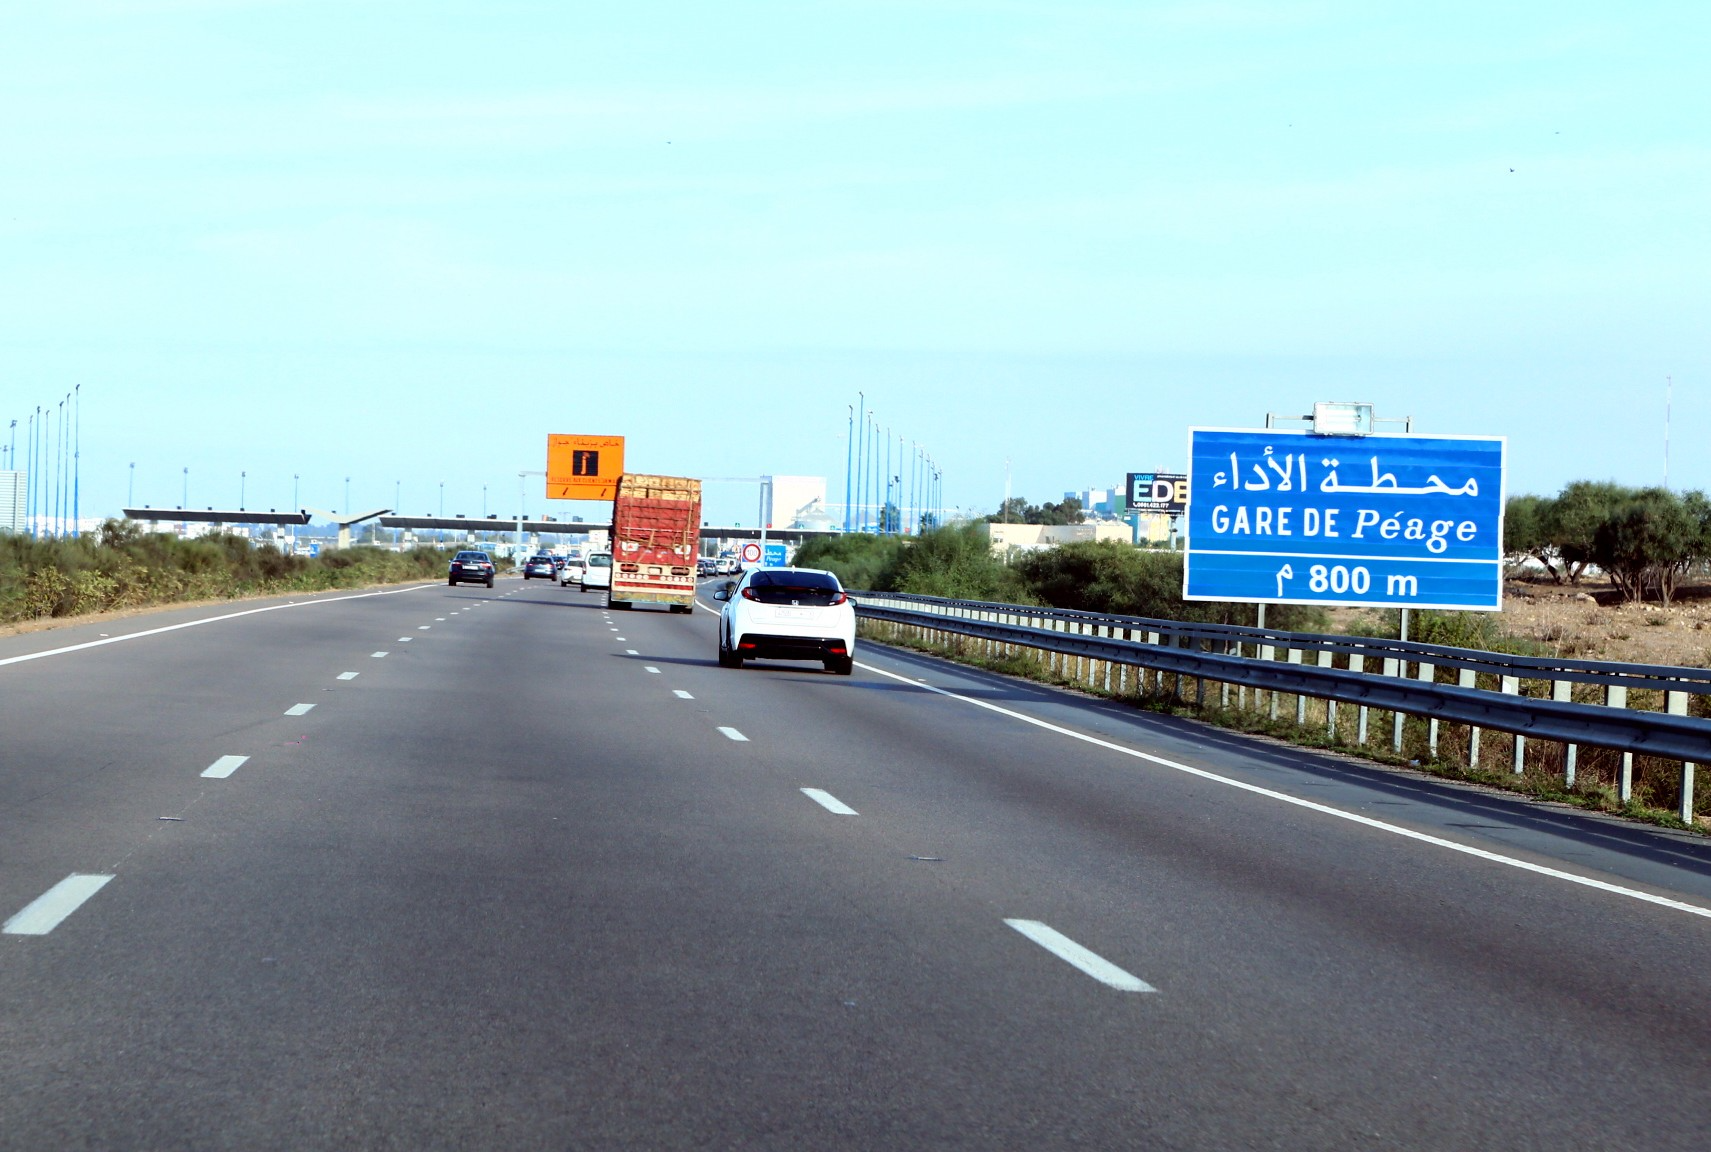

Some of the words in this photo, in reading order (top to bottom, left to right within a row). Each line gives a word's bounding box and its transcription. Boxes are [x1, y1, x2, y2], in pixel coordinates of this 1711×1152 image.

[1212, 445, 1307, 493] الأداء
[1319, 455, 1479, 497] محطة
[1133, 480, 1187, 503] EDE
[1211, 504, 1292, 536] GARE
[1303, 508, 1340, 538] DE
[1351, 508, 1478, 554] Péage
[1308, 564, 1371, 595] 800
[1386, 574, 1418, 597] m
